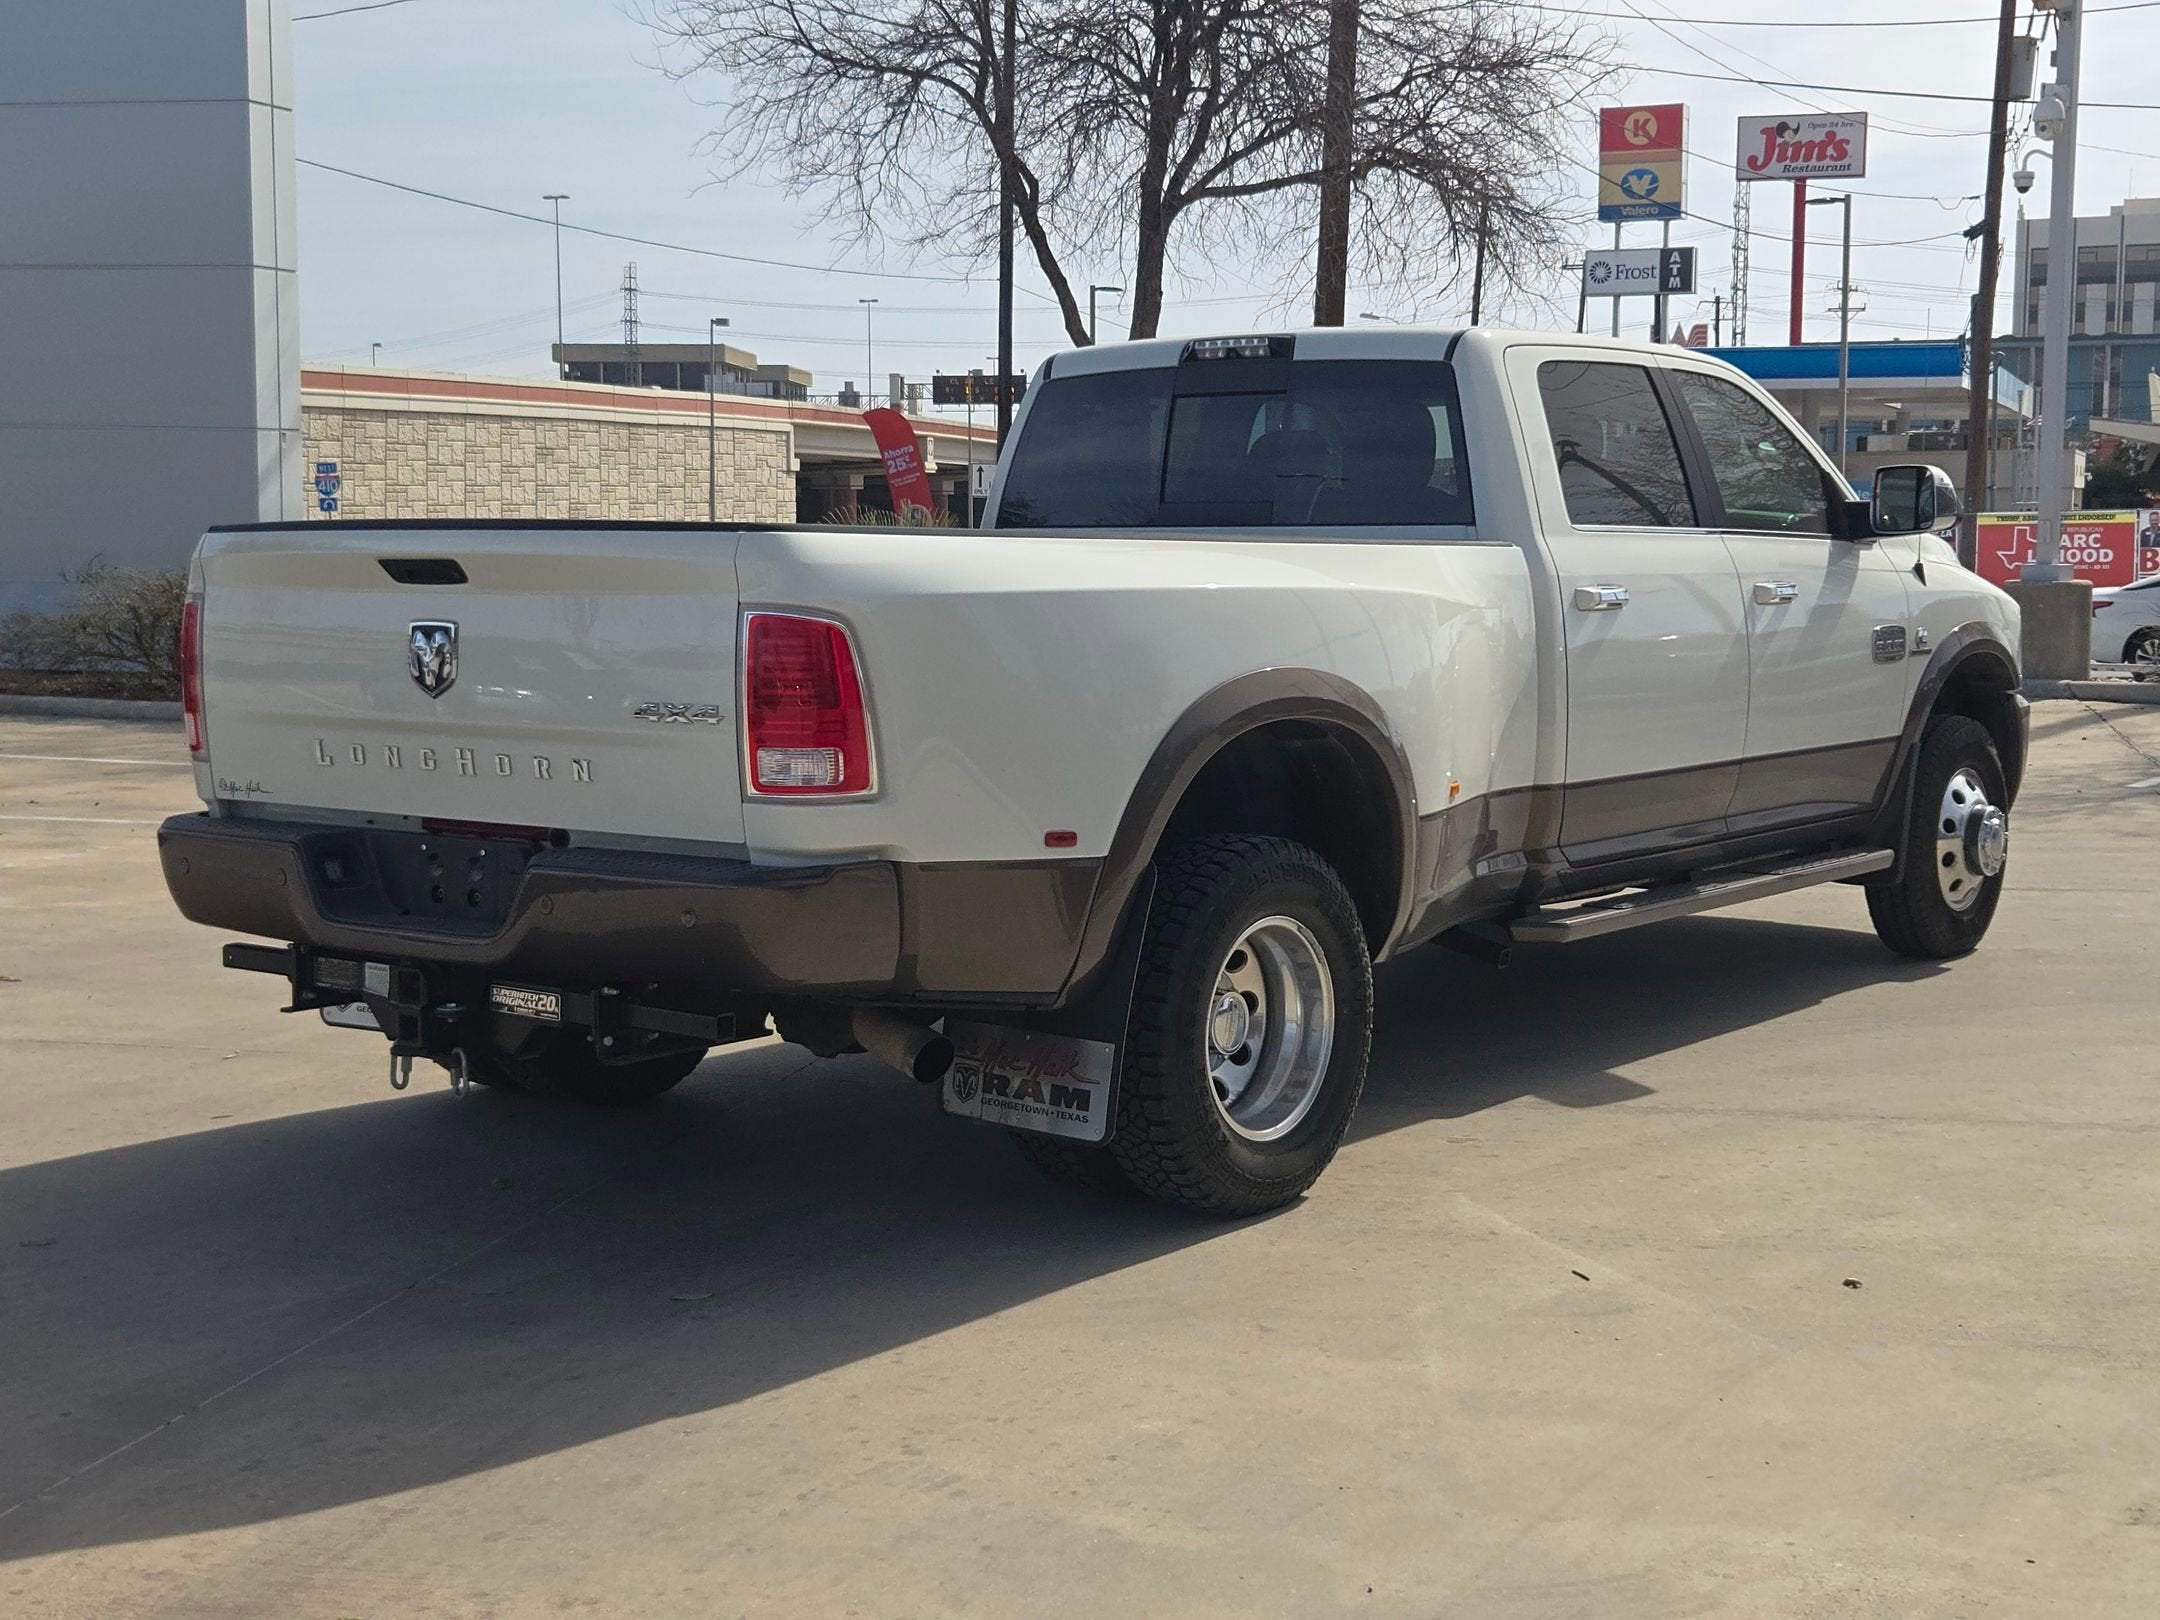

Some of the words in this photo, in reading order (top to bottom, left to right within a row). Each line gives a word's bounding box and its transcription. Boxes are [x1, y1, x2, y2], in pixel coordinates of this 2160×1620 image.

[1632, 118, 1653, 141] K
[1746, 126, 1851, 172] Jim's
[1782, 163, 1852, 174] Restaurant
[1621, 206, 1660, 216] Valero
[1615, 263, 1657, 280] Frost
[1668, 251, 1681, 289] ATM
[884, 445, 914, 460] Ahorra
[319, 481, 338, 492] 410
[2059, 533, 2102, 548] ARC
[313, 738, 594, 783] LONGHORN
[492, 995, 539, 1009] ORIGINAL
[982, 1070, 1091, 1113] RAM
